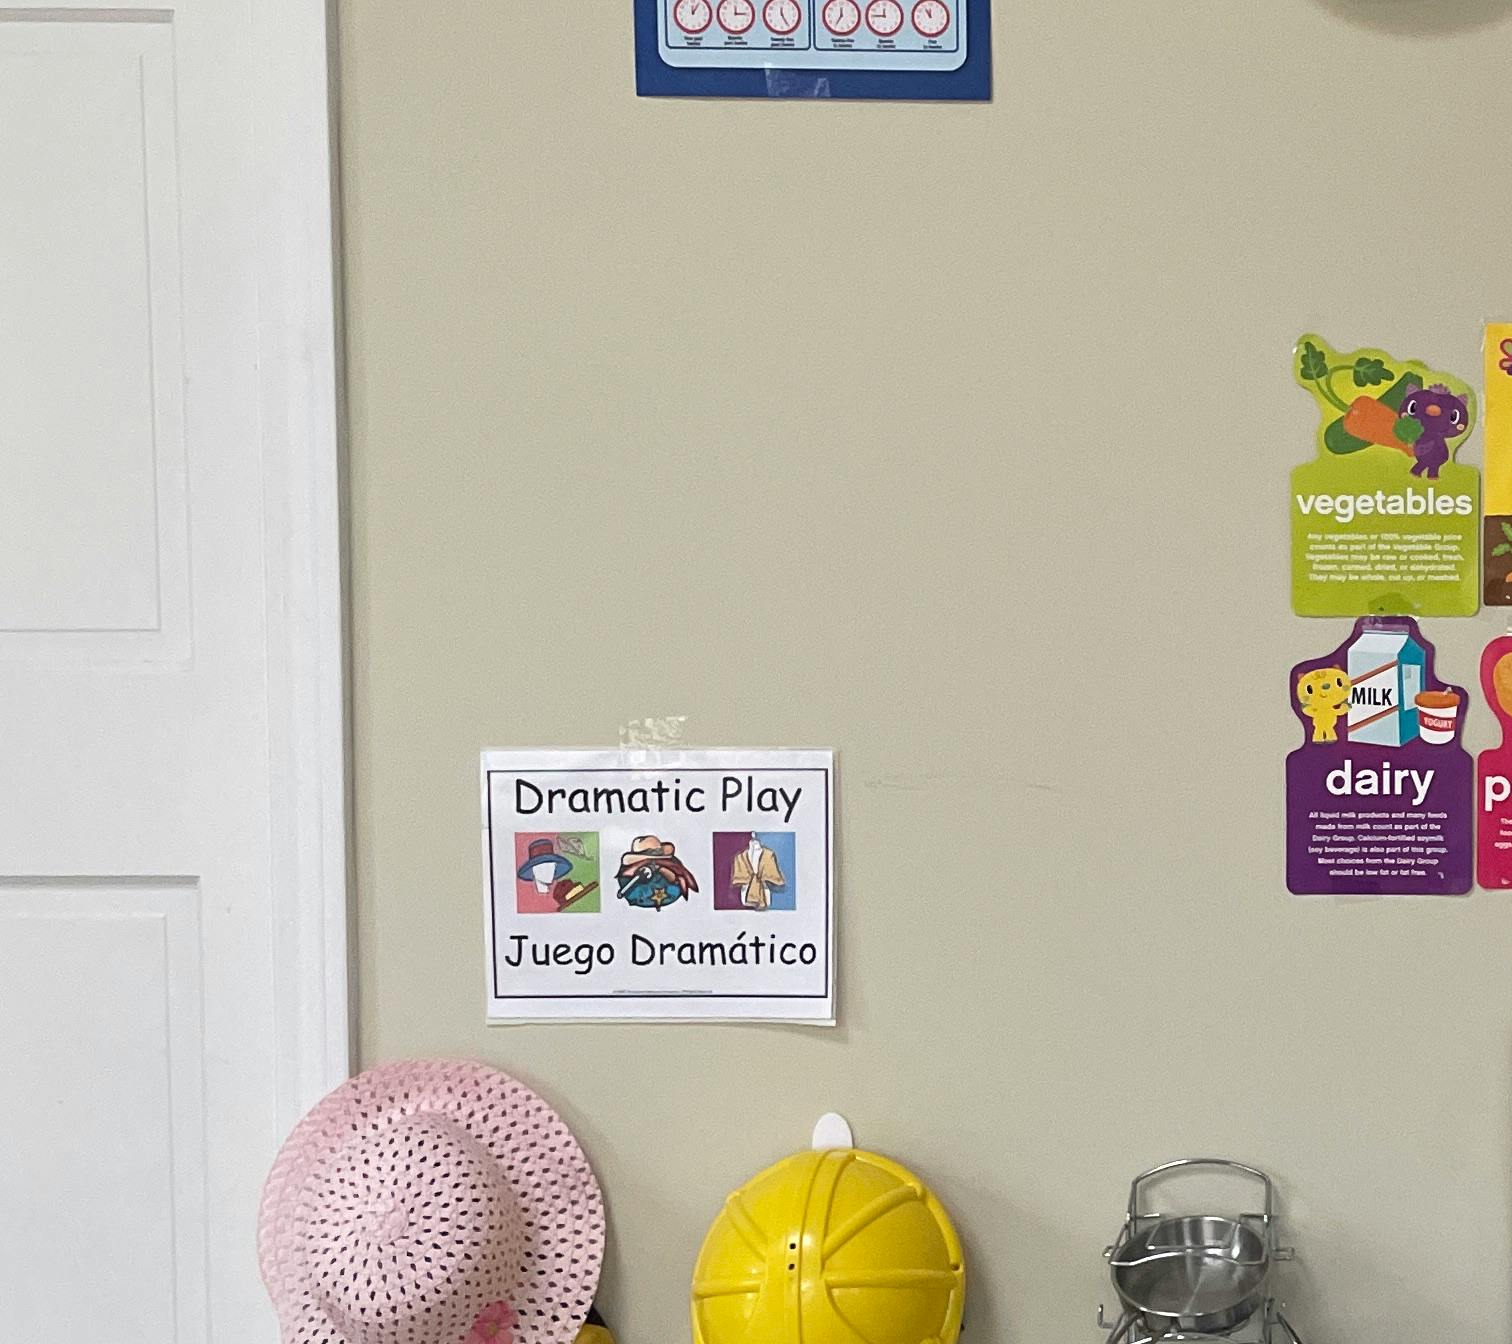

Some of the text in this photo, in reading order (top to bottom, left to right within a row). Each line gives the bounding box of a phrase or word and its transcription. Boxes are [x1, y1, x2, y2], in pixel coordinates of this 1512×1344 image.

[1296, 487, 1473, 523] vegetables
[1352, 687, 1392, 706] MILK
[515, 775, 802, 823] Dramatic Play
[1325, 759, 1435, 806] dairy
[504, 931, 817, 975] Juego Dramático
